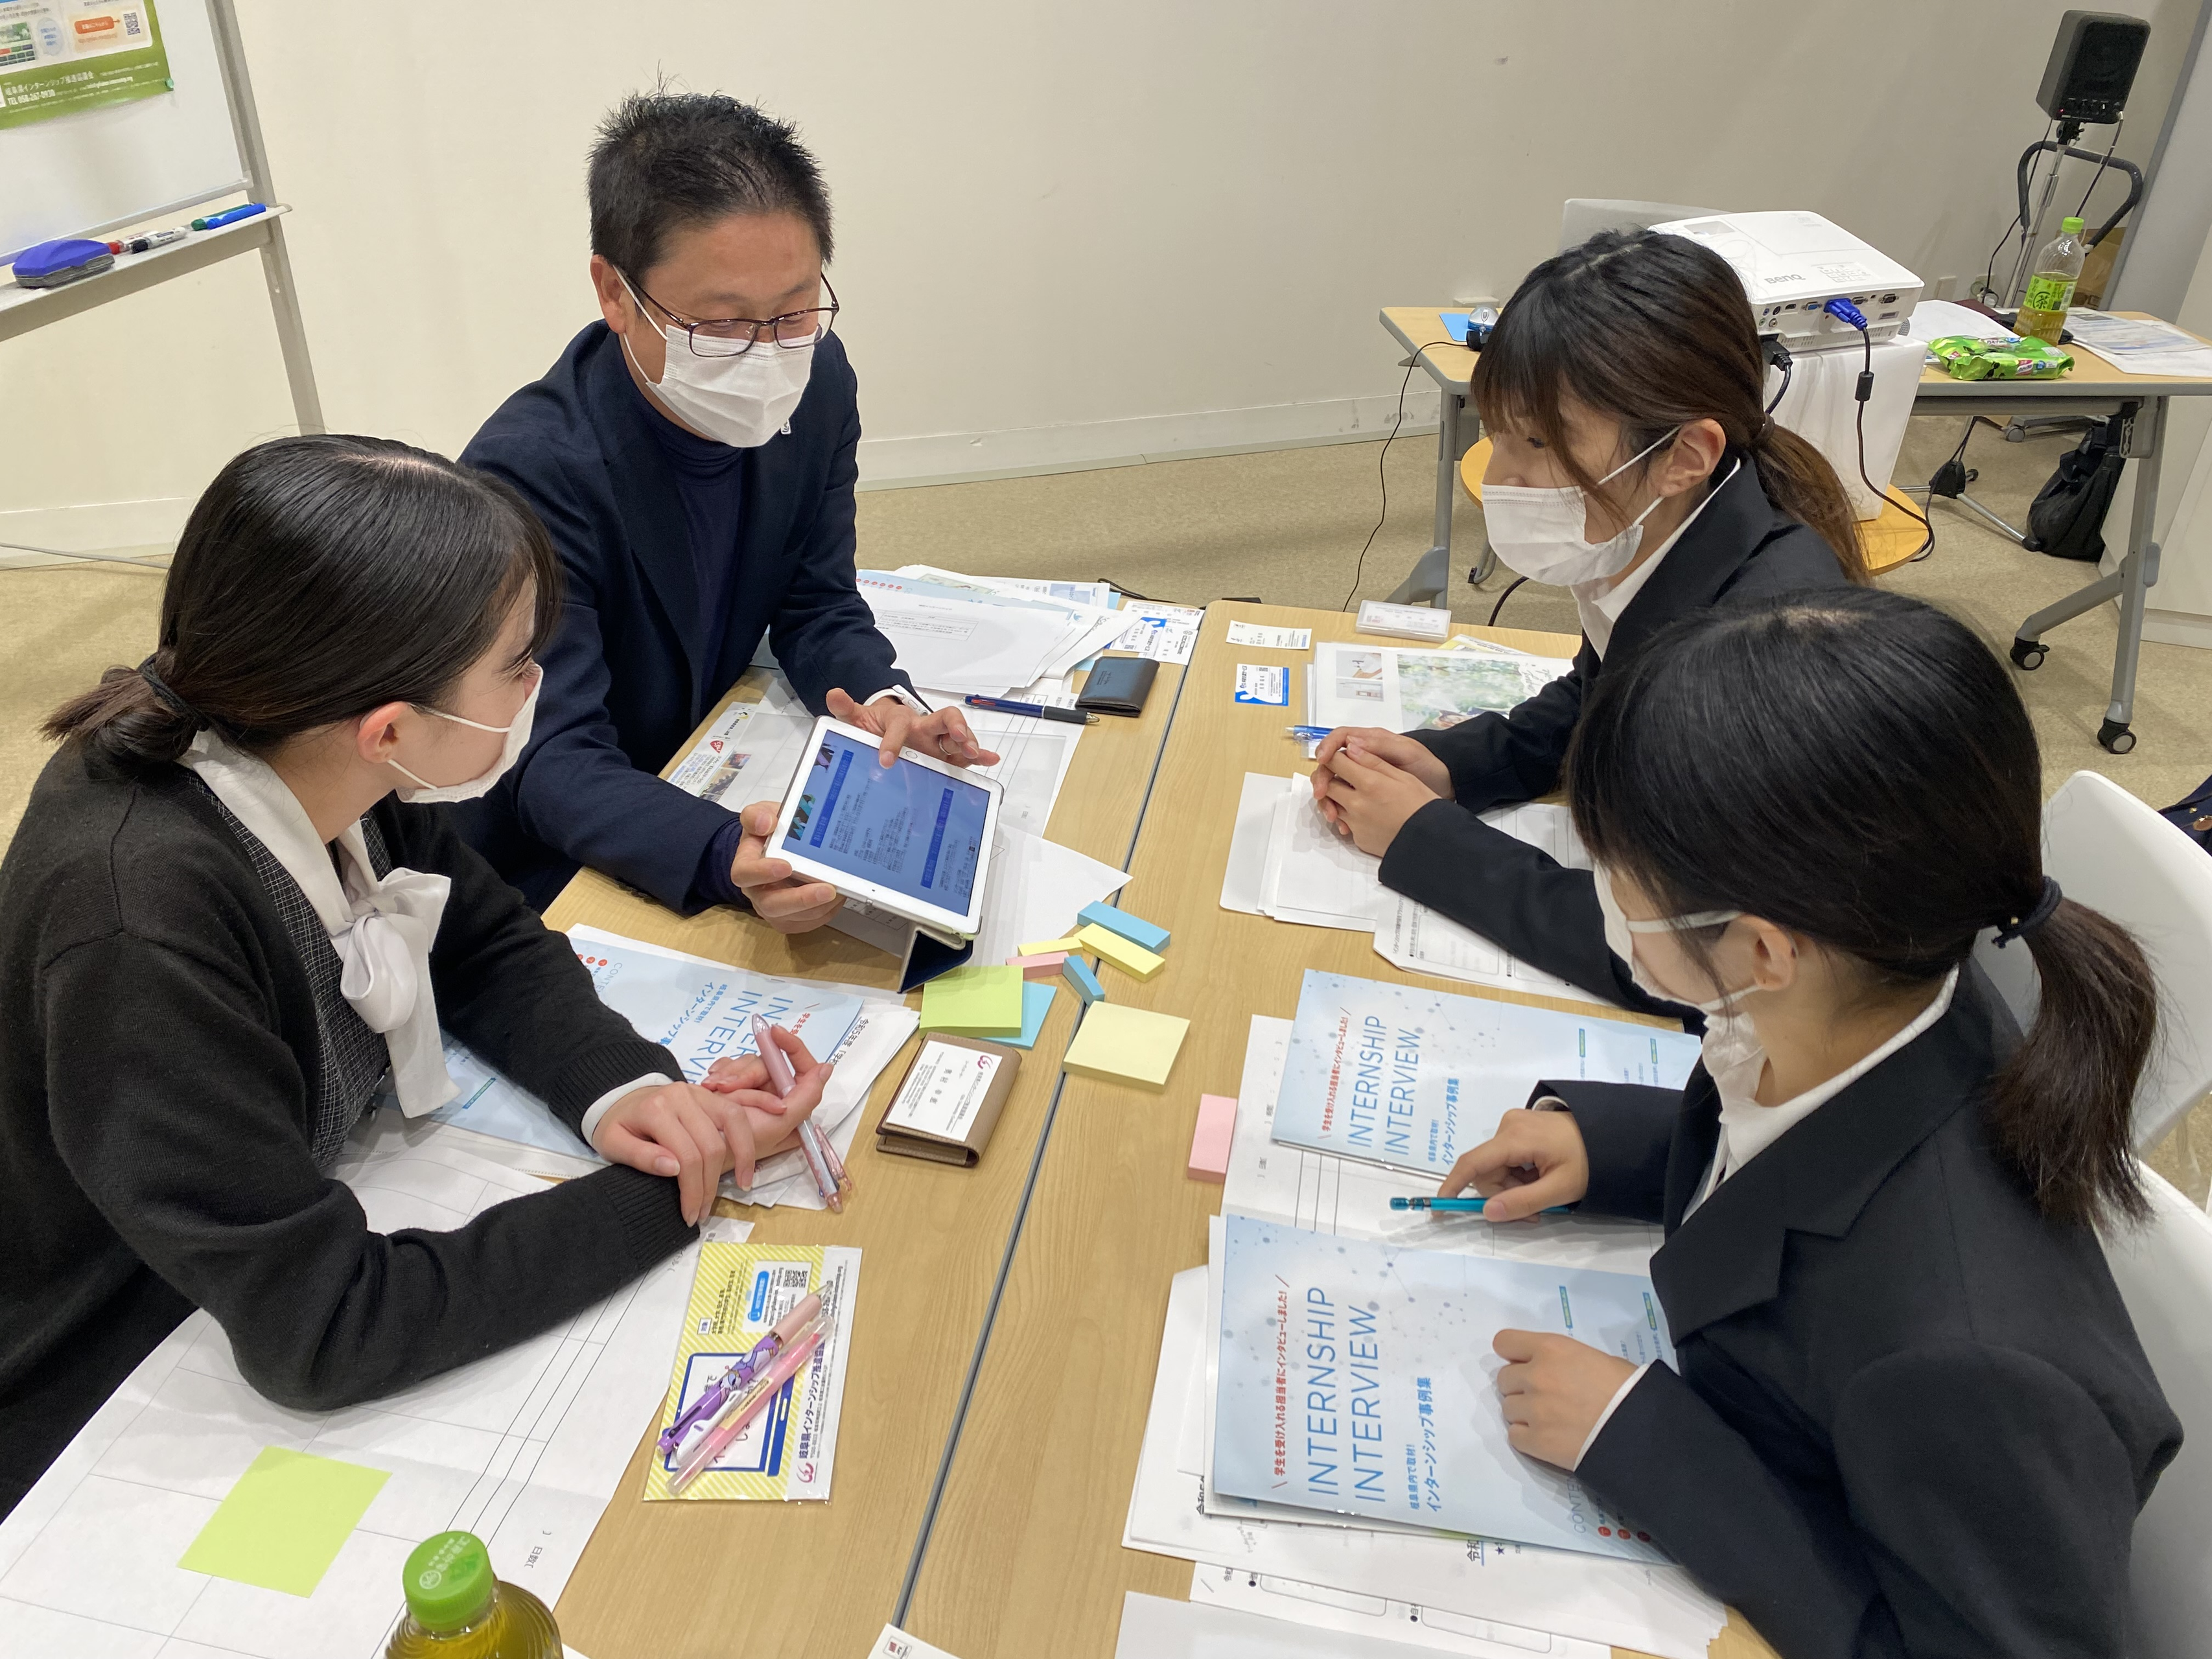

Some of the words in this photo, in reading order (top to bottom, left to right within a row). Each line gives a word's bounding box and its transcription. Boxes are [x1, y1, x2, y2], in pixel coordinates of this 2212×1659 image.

[1764, 273, 1806, 284] BenQ
[596, 962, 623, 993] CONTE
[1347, 1015, 1387, 1148] INTERNSHIP
[1384, 1028, 1421, 1155] INTERVIEW
[1441, 1078, 1460, 1166] インターンシップ事例集
[1274, 1290, 1287, 1477] 学生を受け入れる担当者にインタビューしました!
[1307, 1287, 1338, 1495] INTERNSHIP
[1348, 1305, 1386, 1502] INTERVIEW
[1417, 1376, 1443, 1513] インターンシップ事例集
[1405, 1444, 1420, 1511] 岐阜県内で取材!
